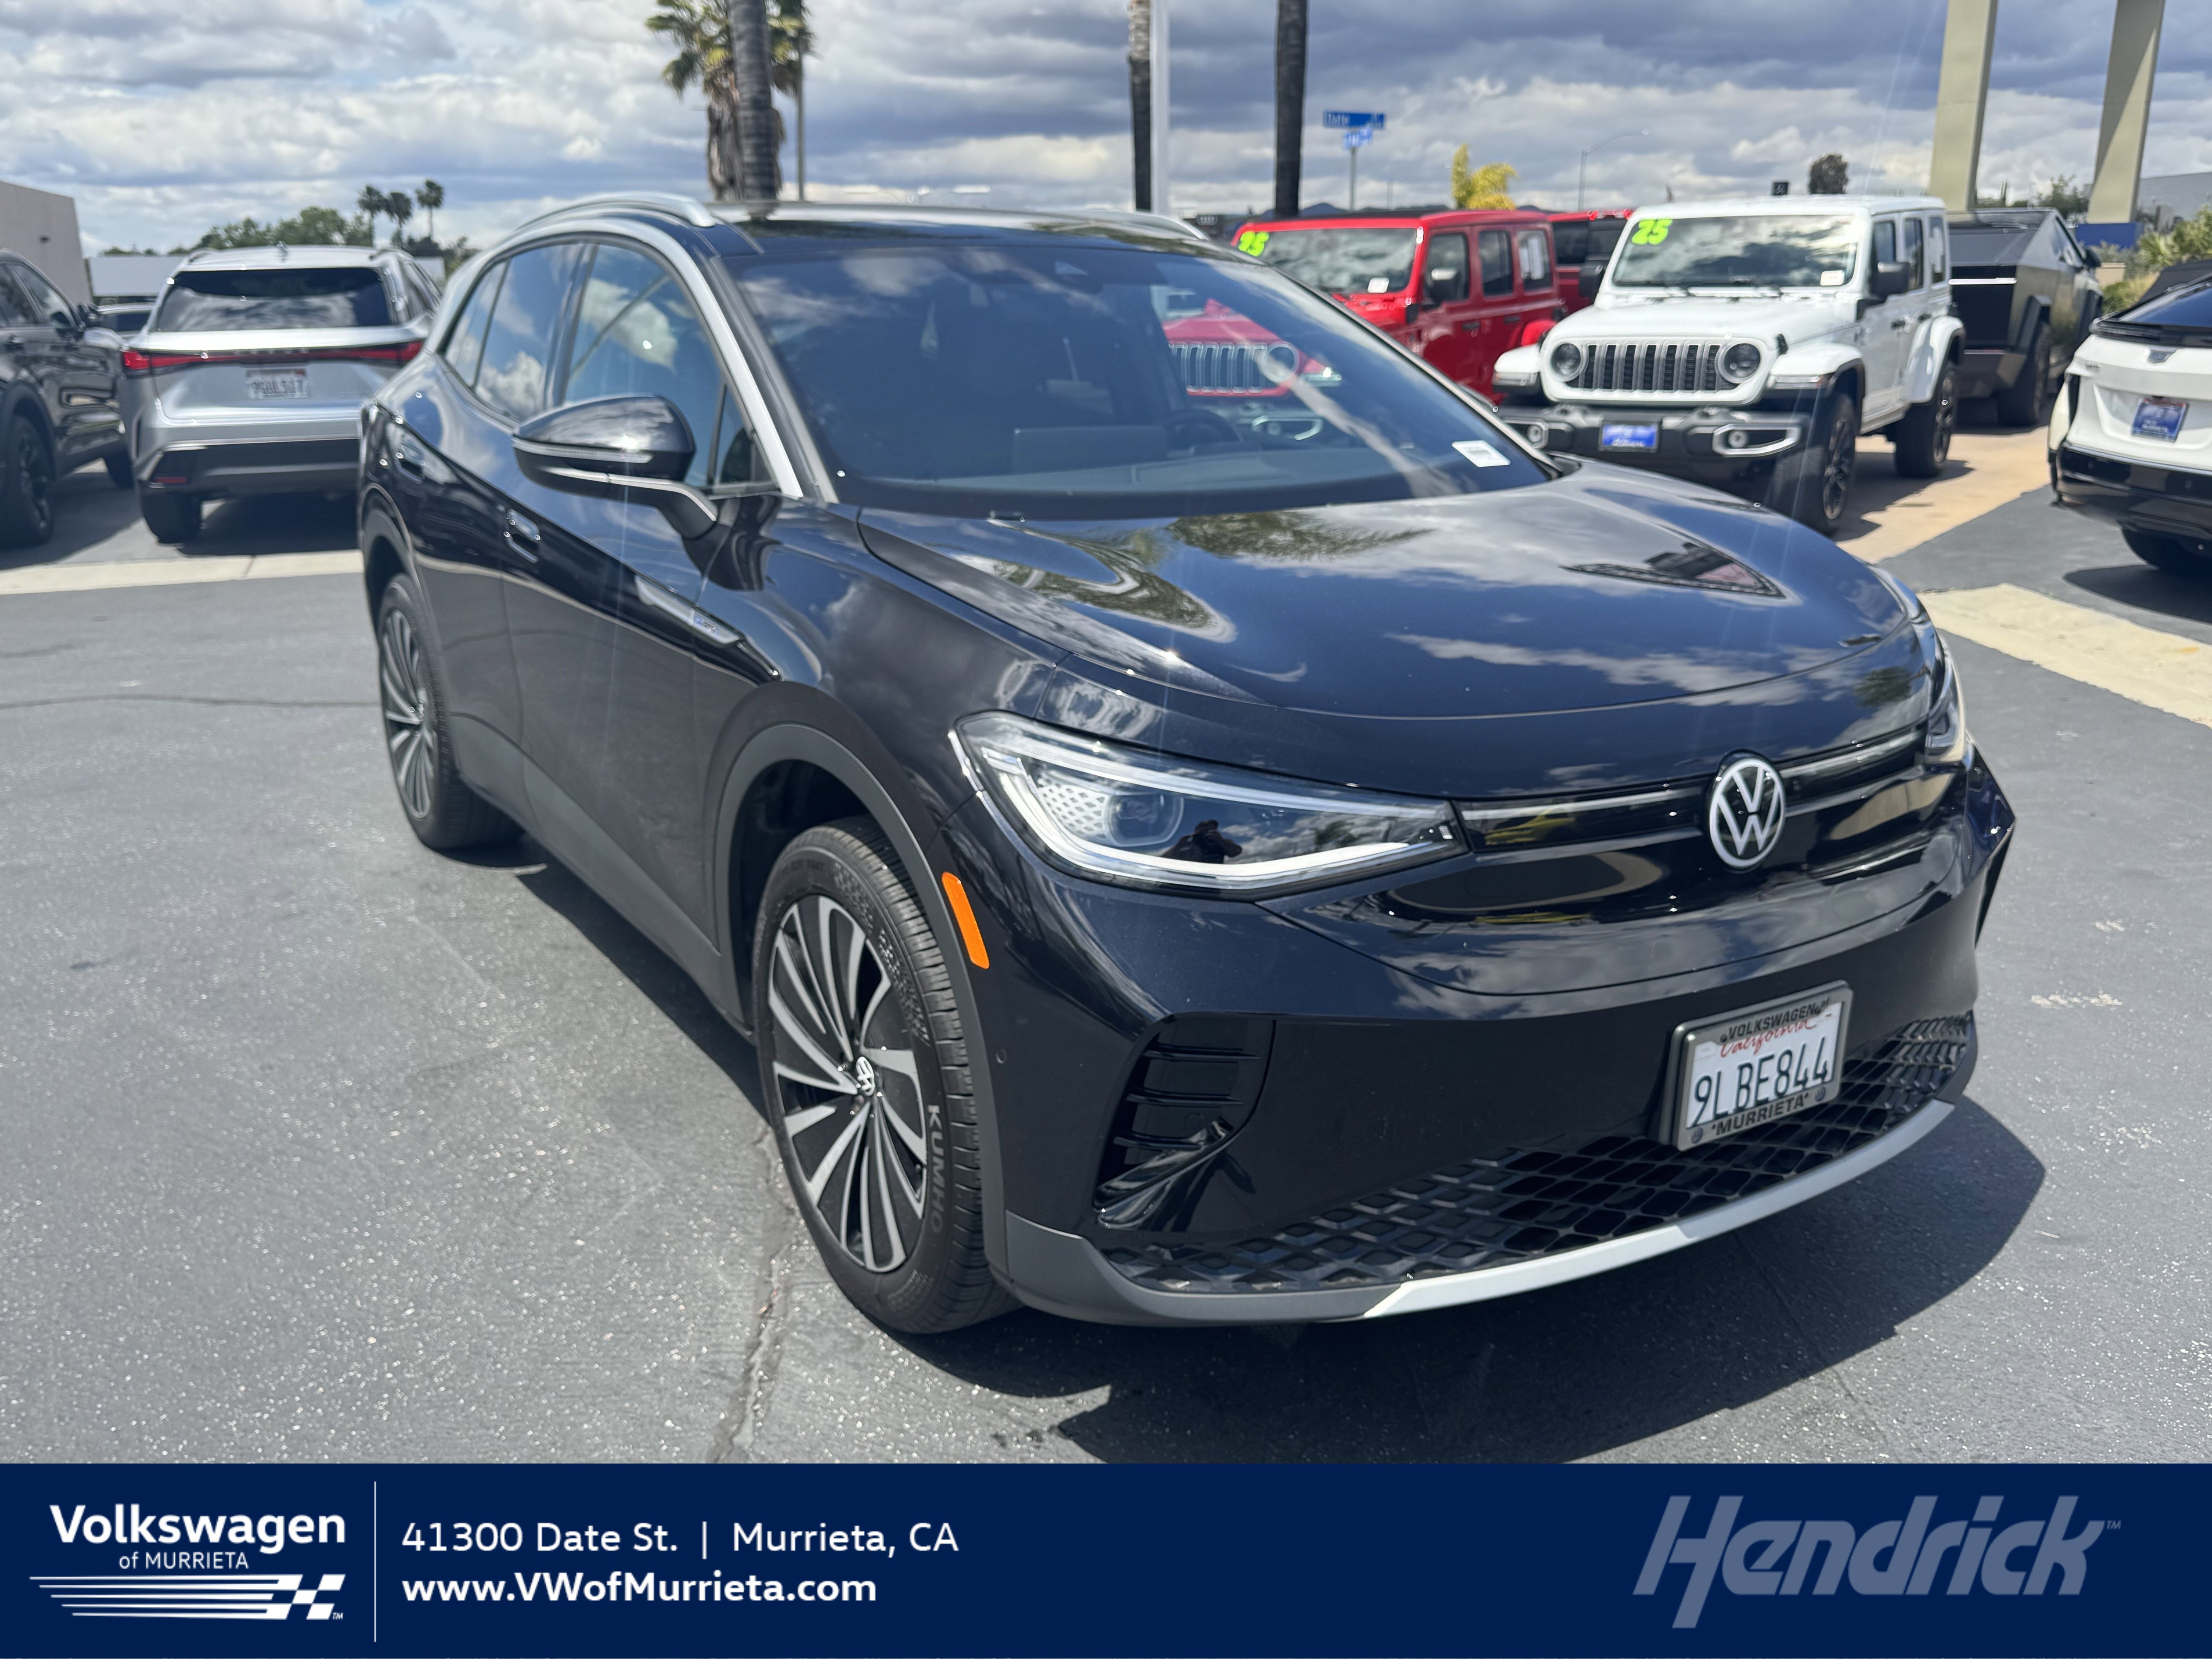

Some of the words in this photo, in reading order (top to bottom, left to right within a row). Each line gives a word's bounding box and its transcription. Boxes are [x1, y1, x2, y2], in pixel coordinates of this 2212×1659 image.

[1632, 218, 1673, 246] 25
[1713, 761, 1783, 862] VW
[1728, 1003, 1815, 1039] VOLKSWAGEN
[1692, 1037, 1828, 1127] 9LBE844
[927, 1104, 945, 1233] KUMHO
